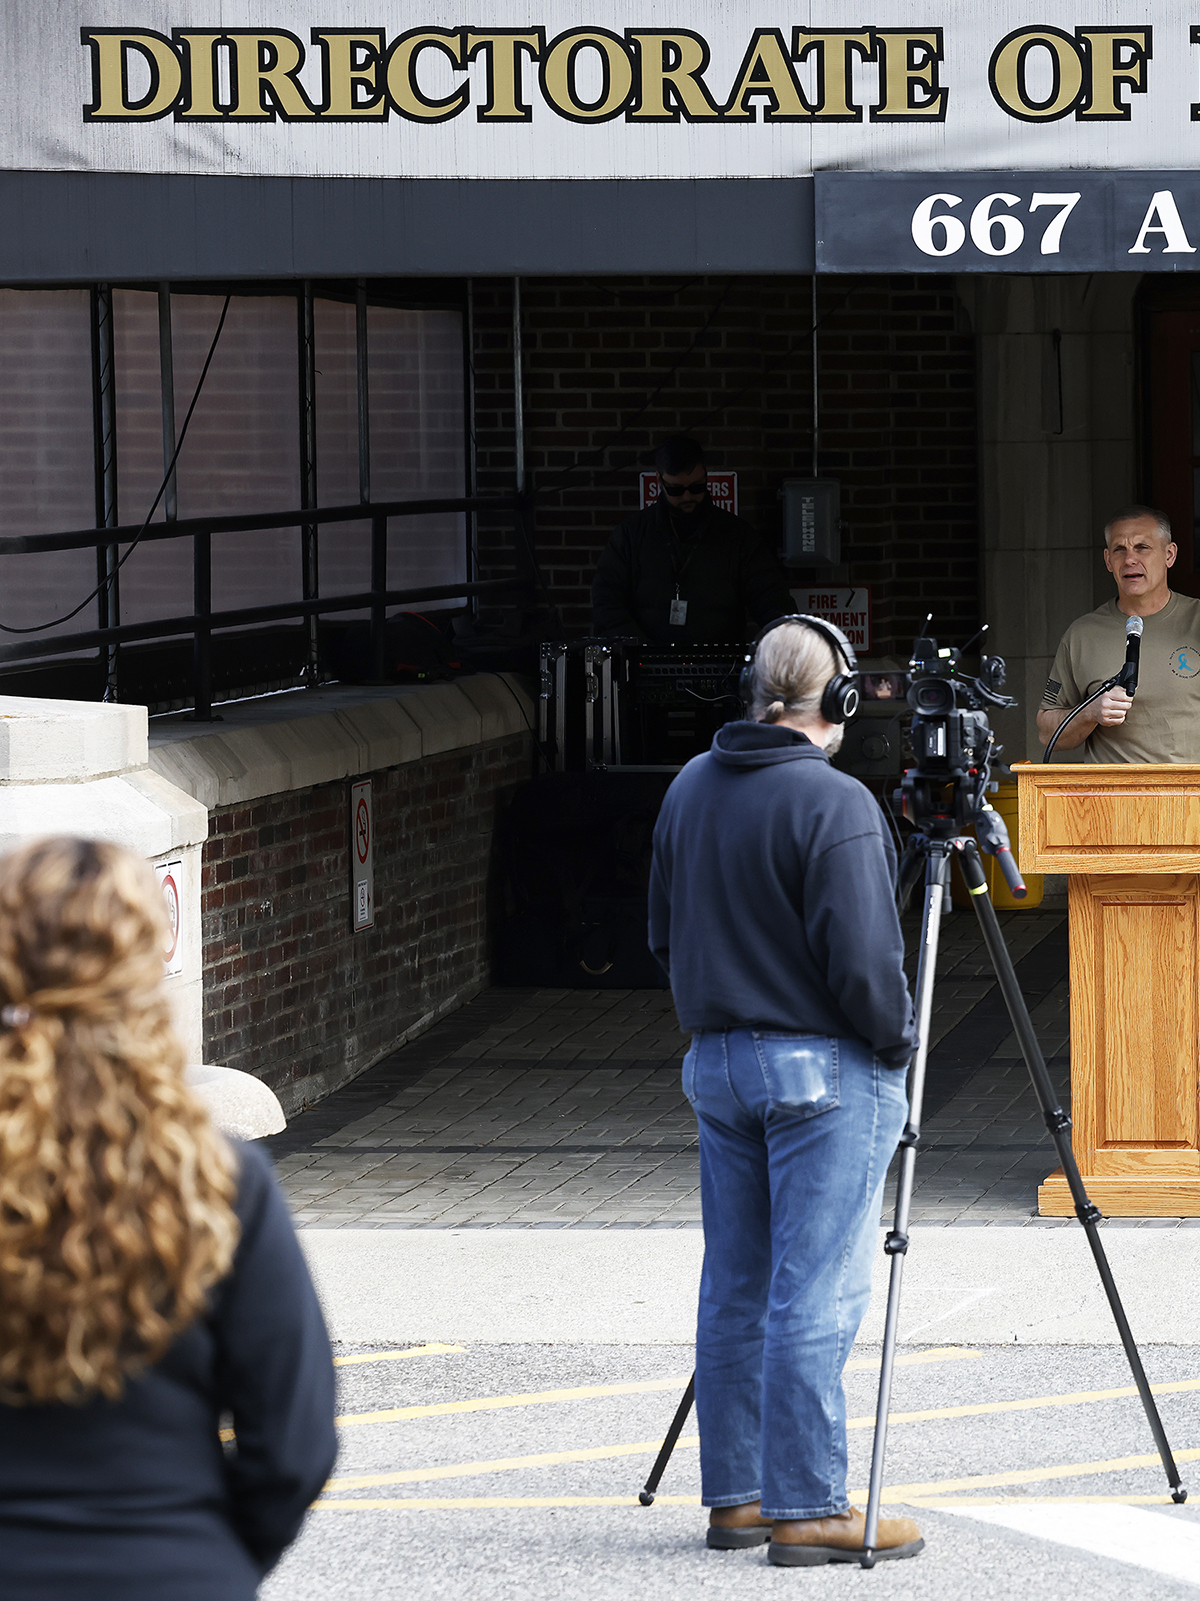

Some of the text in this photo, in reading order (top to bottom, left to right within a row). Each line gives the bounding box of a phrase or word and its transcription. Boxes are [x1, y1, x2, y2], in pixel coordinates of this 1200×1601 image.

[80, 26, 949, 124] DIRECTORATE
[989, 25, 1152, 123] OF
[911, 192, 1082, 256] 667
[808, 595, 837, 609] FIRE
